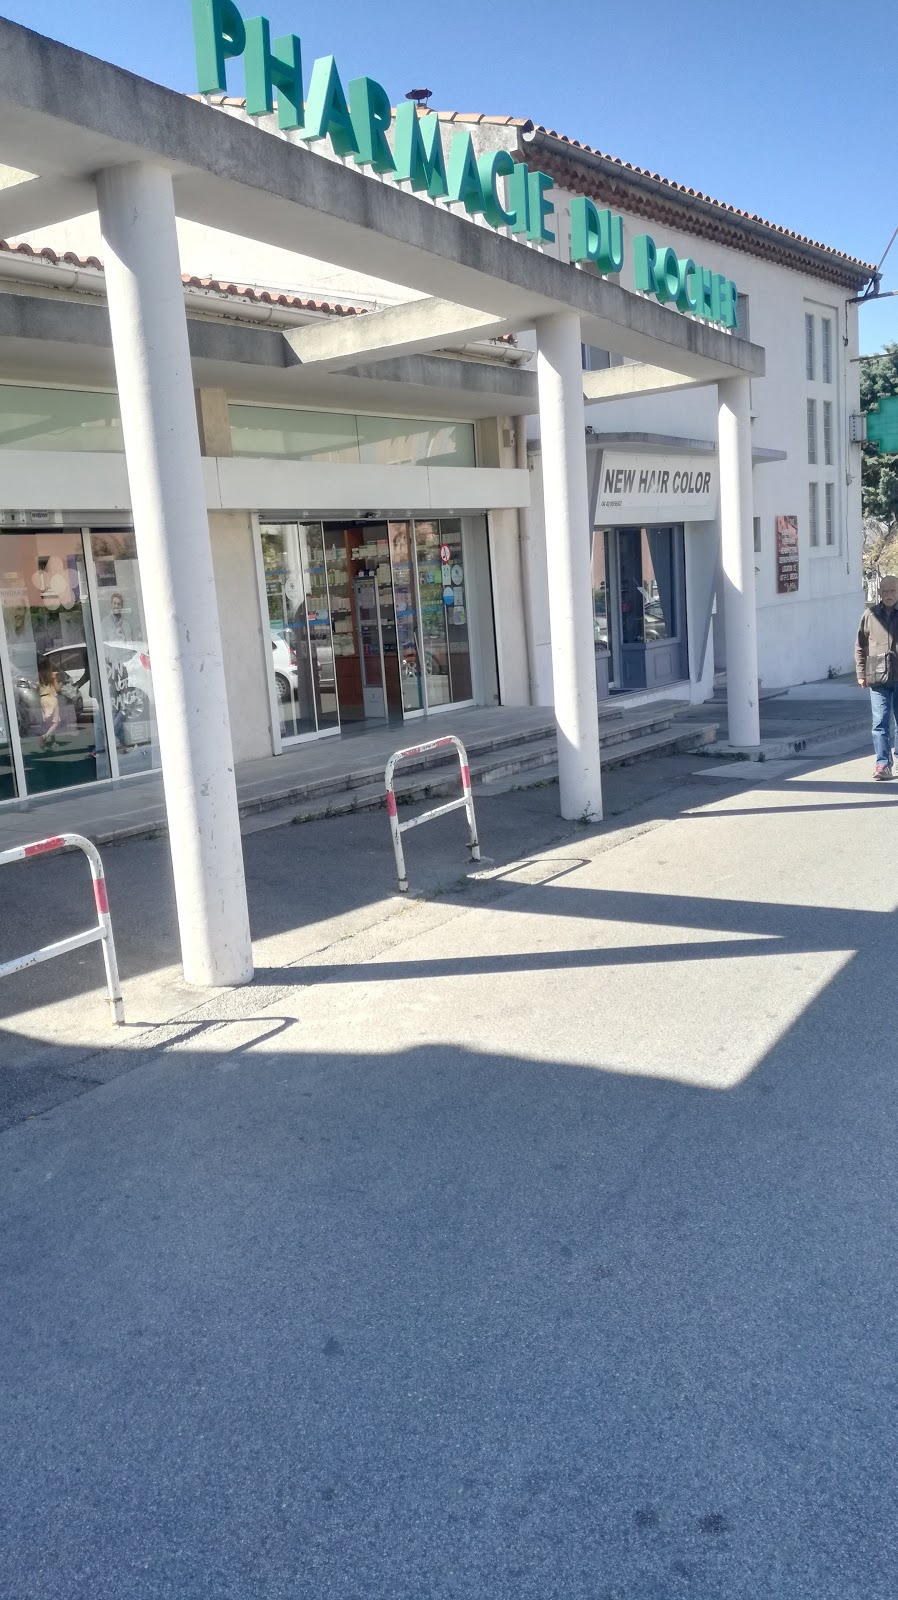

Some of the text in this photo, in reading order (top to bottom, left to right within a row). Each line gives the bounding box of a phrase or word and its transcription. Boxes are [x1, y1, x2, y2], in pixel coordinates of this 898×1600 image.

[191, 0, 738, 329] PHARMACIE DU ROCHER
[604, 469, 711, 494] NEW HAIR COLOR
